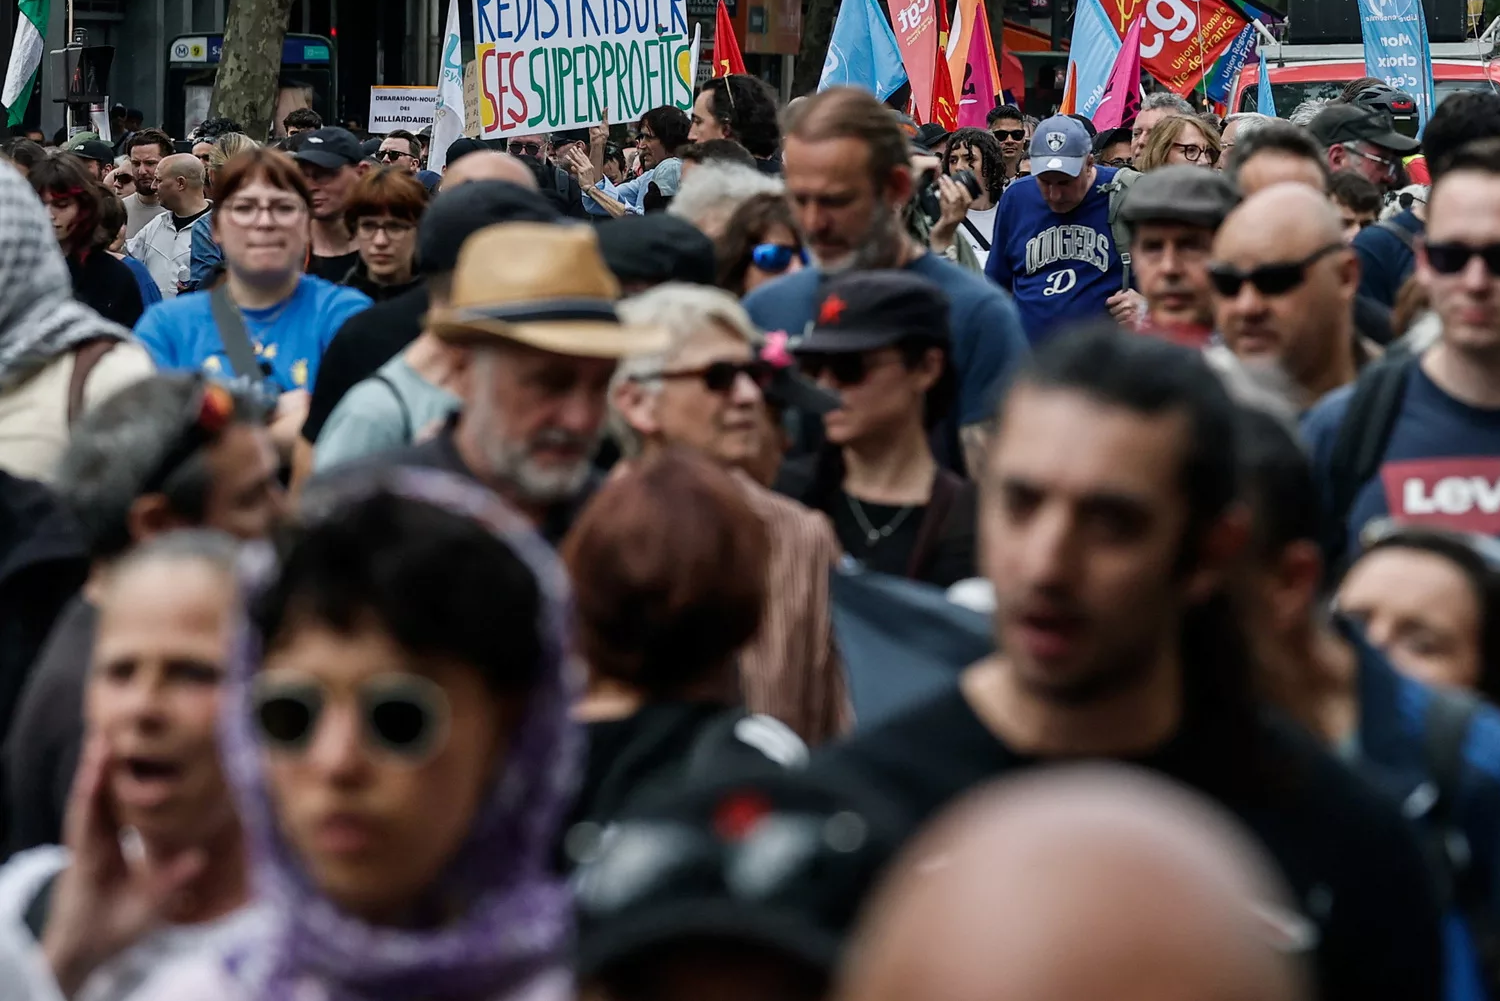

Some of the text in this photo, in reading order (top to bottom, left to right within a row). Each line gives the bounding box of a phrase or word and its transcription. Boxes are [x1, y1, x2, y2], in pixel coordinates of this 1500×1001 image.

[1171, 43, 1196, 71] Union
[375, 94, 438, 103] DEBARASSONS-NOUS
[481, 49, 528, 133] SES
[374, 115, 434, 124] MILLIARDAIRES
[1025, 224, 1110, 275] DODGERS
